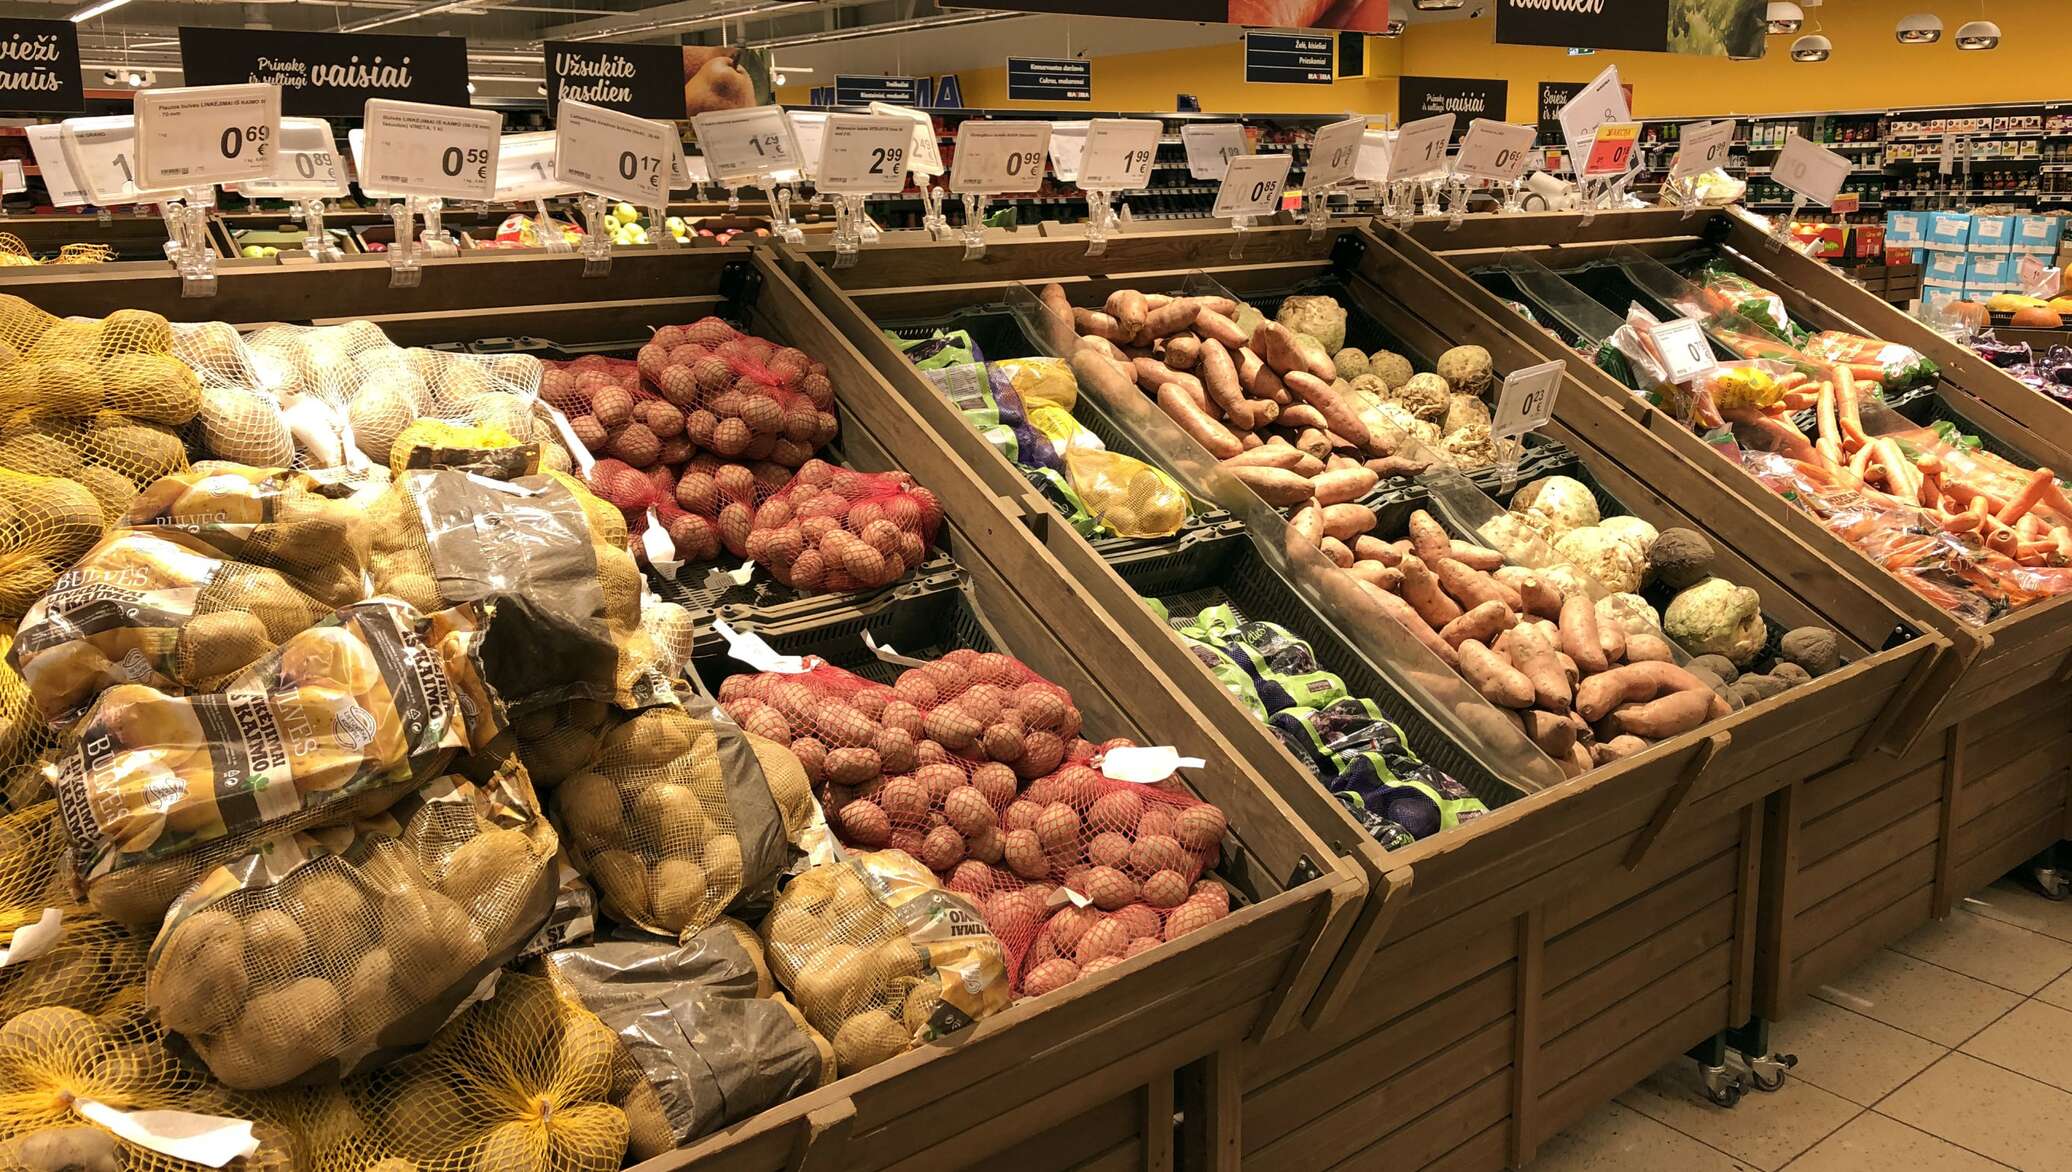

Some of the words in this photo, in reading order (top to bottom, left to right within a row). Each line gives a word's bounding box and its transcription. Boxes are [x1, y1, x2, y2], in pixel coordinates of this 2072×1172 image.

[257, 57, 306, 74] Prinokę
[311, 55, 413, 88] vaisiai
[555, 53, 636, 78] Užsukite
[558, 78, 632, 102] kasdien
[1446, 92, 1486, 112] vaisiai
[221, 126, 243, 159] 0
[246, 125, 270, 142] 69
[257, 143, 269, 156] €
[749, 137, 764, 156] 1
[1426, 142, 1433, 160] 1
[1435, 138, 1445, 150] 15
[442, 147, 464, 177] 0
[467, 148, 489, 164] 59
[869, 147, 886, 174] 2
[887, 148, 903, 161] 99
[1124, 150, 1134, 173] 1
[1136, 151, 1150, 163] 99
[1219, 147, 1228, 165] 1
[1331, 147, 1341, 168] 0
[1496, 149, 1510, 168] 0
[1614, 147, 1623, 162] 0
[1707, 145, 1716, 161] 0
[296, 152, 315, 179] 0
[313, 153, 333, 167] 89
[478, 166, 488, 179] €
[619, 151, 638, 180] 0
[641, 156, 661, 173] 17
[893, 163, 901, 174] €
[1007, 152, 1022, 176] 0
[1024, 152, 1041, 165] 99
[1031, 166, 1039, 176] €
[1140, 164, 1147, 173] €
[650, 175, 659, 187] €
[1251, 181, 1264, 201] 0
[1264, 181, 1277, 192] 85
[1688, 343, 1701, 362] 0
[1523, 393, 1533, 415] 0
[1534, 389, 1544, 402] 23
[414, 649, 443, 720] KAIMO
[234, 703, 270, 772] KAIMO
